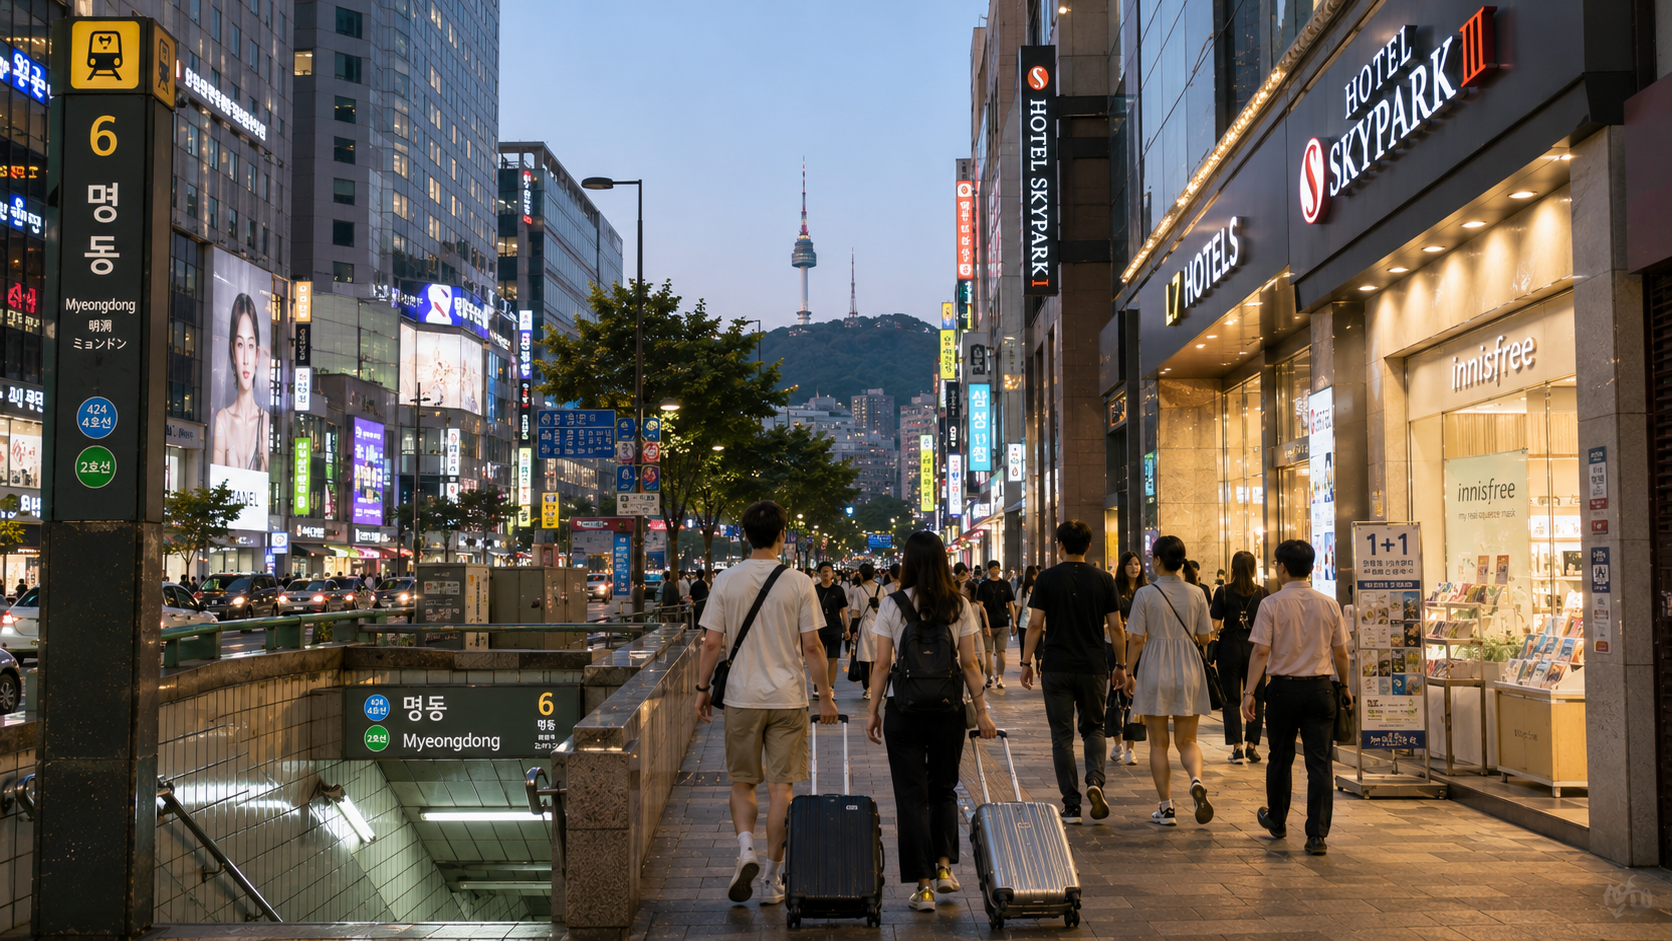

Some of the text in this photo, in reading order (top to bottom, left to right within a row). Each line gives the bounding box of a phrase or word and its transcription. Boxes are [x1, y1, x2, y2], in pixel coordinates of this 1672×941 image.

[1344, 25, 1415, 120] HOTEL
[1330, 36, 1457, 198] SKYPARK
[89, 115, 118, 156] 6
[1030, 98, 1048, 171] HOTEL
[84, 182, 120, 275] 명동
[1031, 178, 1049, 276] SKYPARK
[1165, 216, 1241, 326] L7 HOTELS
[65, 297, 136, 314] Myeongdong
[73, 337, 127, 350] ミョンドン
[1451, 335, 1536, 390] innisfree
[86, 404, 107, 415] 424
[80, 460, 111, 474] 2호선
[1458, 478, 1516, 505] innisfree
[1366, 532, 1409, 556] 1+1
[403, 695, 448, 722] 명동
[538, 691, 554, 716] 6
[403, 732, 501, 752] Myeongdong
